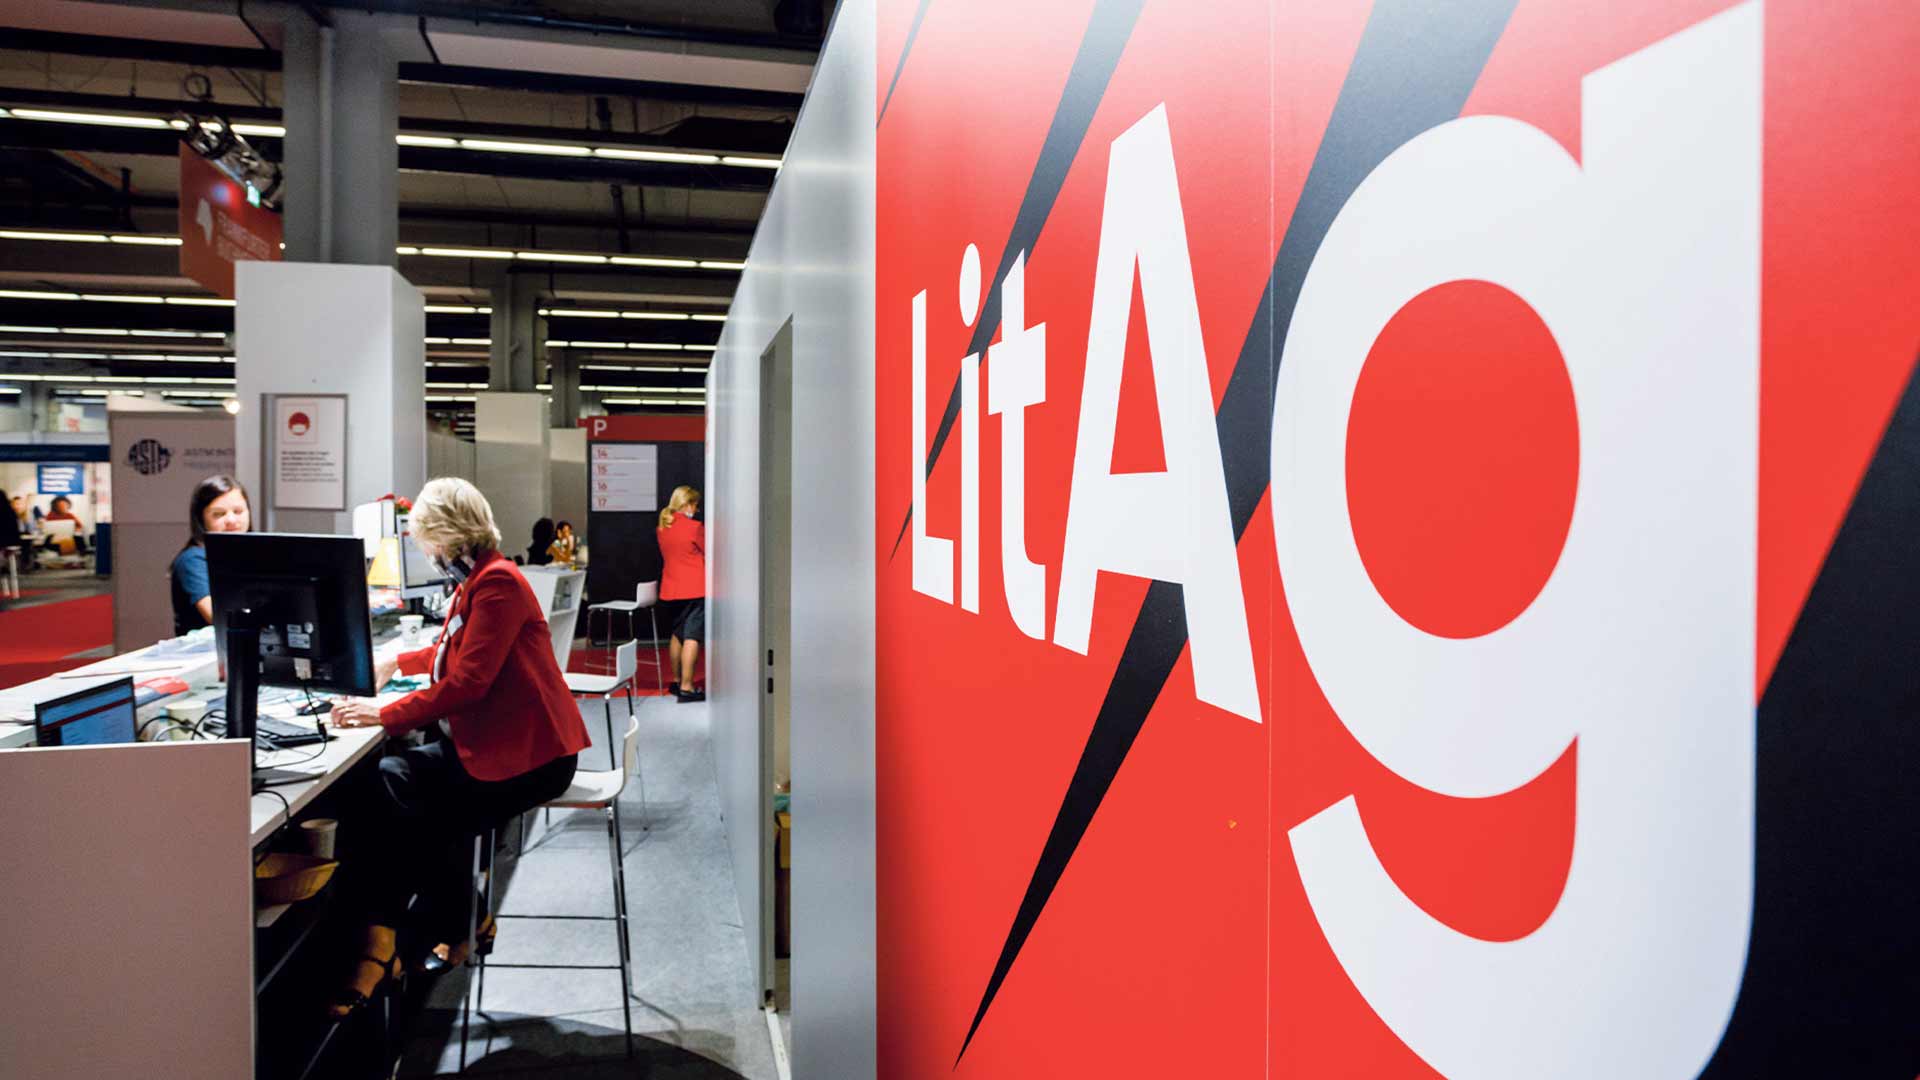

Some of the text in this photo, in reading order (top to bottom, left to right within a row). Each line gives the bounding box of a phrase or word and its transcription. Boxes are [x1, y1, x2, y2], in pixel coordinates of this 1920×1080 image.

[594, 419, 607, 437] P
[597, 449, 608, 459] 14
[597, 464, 608, 476] 15
[597, 480, 608, 492] 16
[597, 497, 608, 508] 17
[911, 0, 1765, 1080] LitAg
